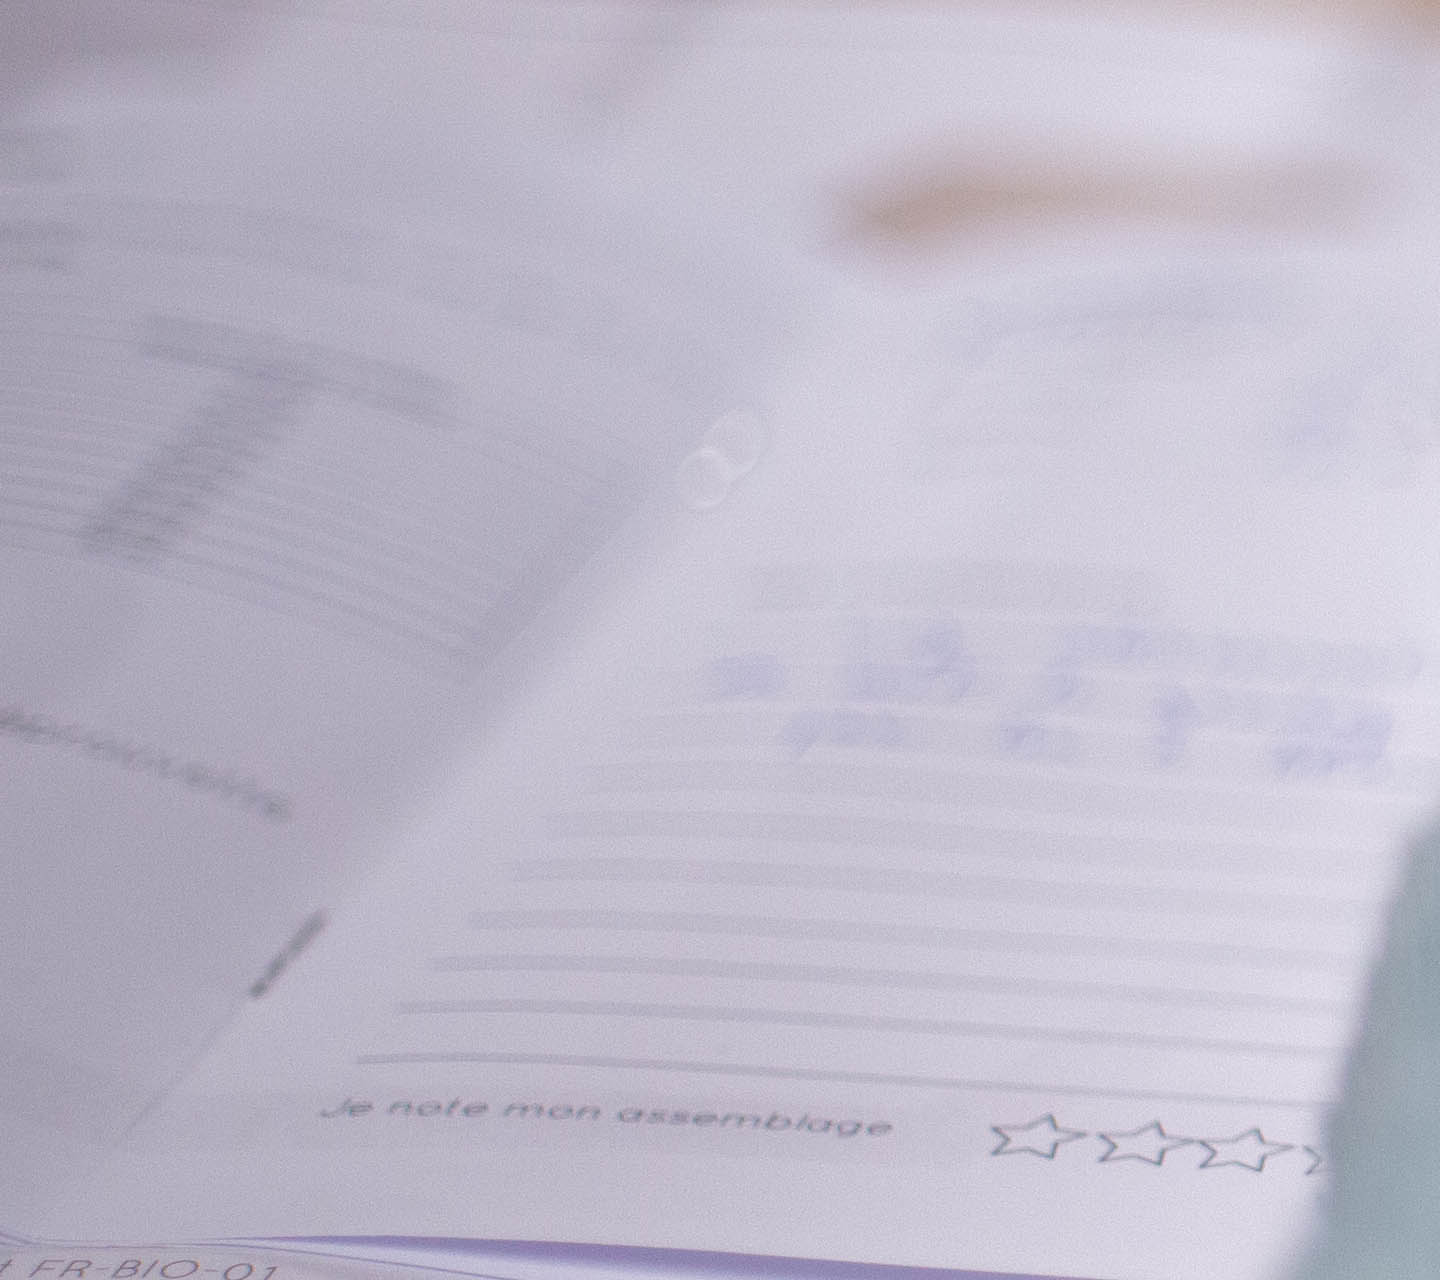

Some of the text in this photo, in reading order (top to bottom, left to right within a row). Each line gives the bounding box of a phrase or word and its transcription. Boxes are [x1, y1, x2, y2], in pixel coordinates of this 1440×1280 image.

[319, 1097, 895, 1138] Je note mon assemblage
